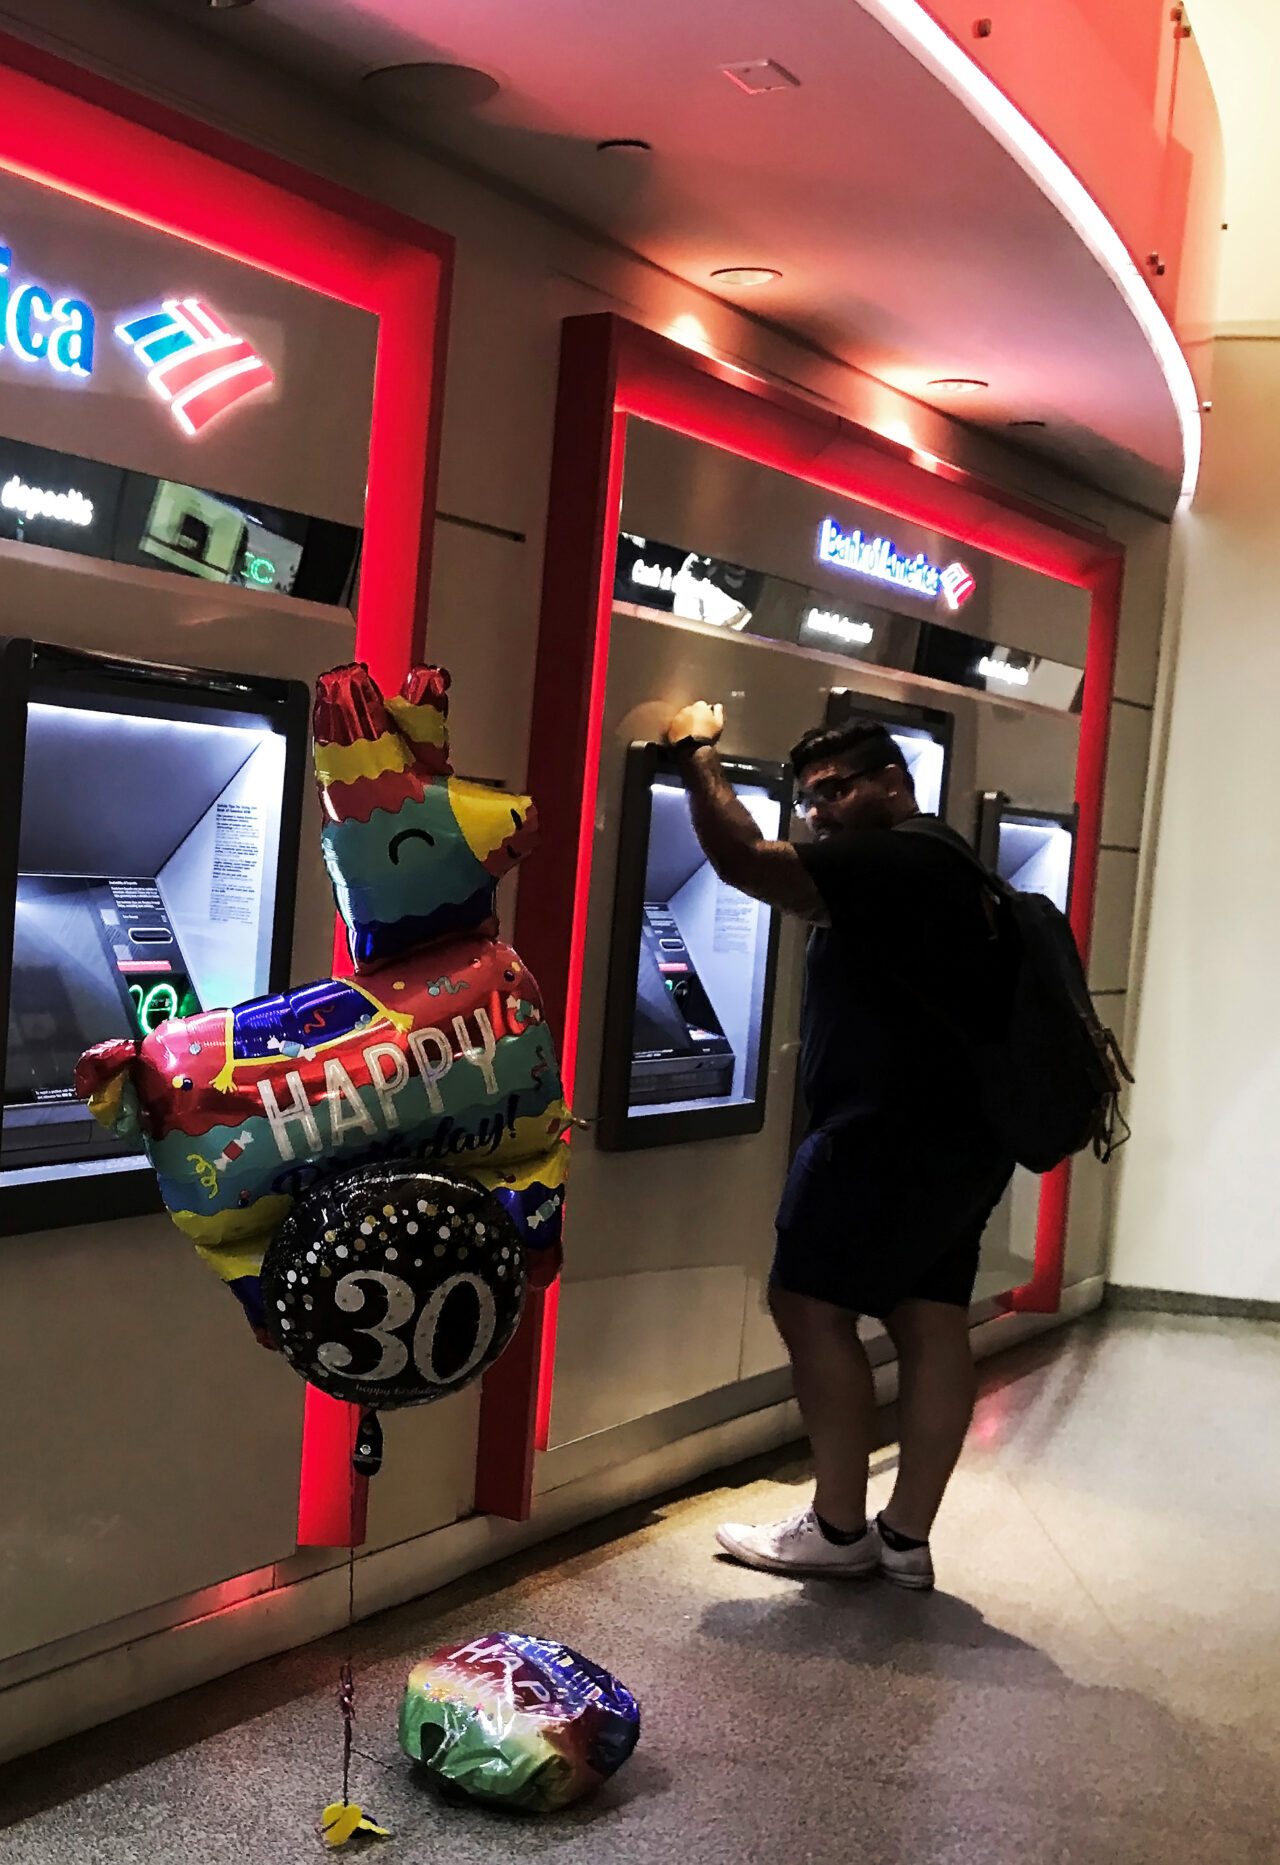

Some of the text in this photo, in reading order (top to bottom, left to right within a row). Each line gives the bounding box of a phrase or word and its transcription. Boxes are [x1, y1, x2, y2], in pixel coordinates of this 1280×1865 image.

[1, 475, 94, 527] deposits
[256, 1008, 499, 1162] HAPPY
[316, 1269, 497, 1385] 30
